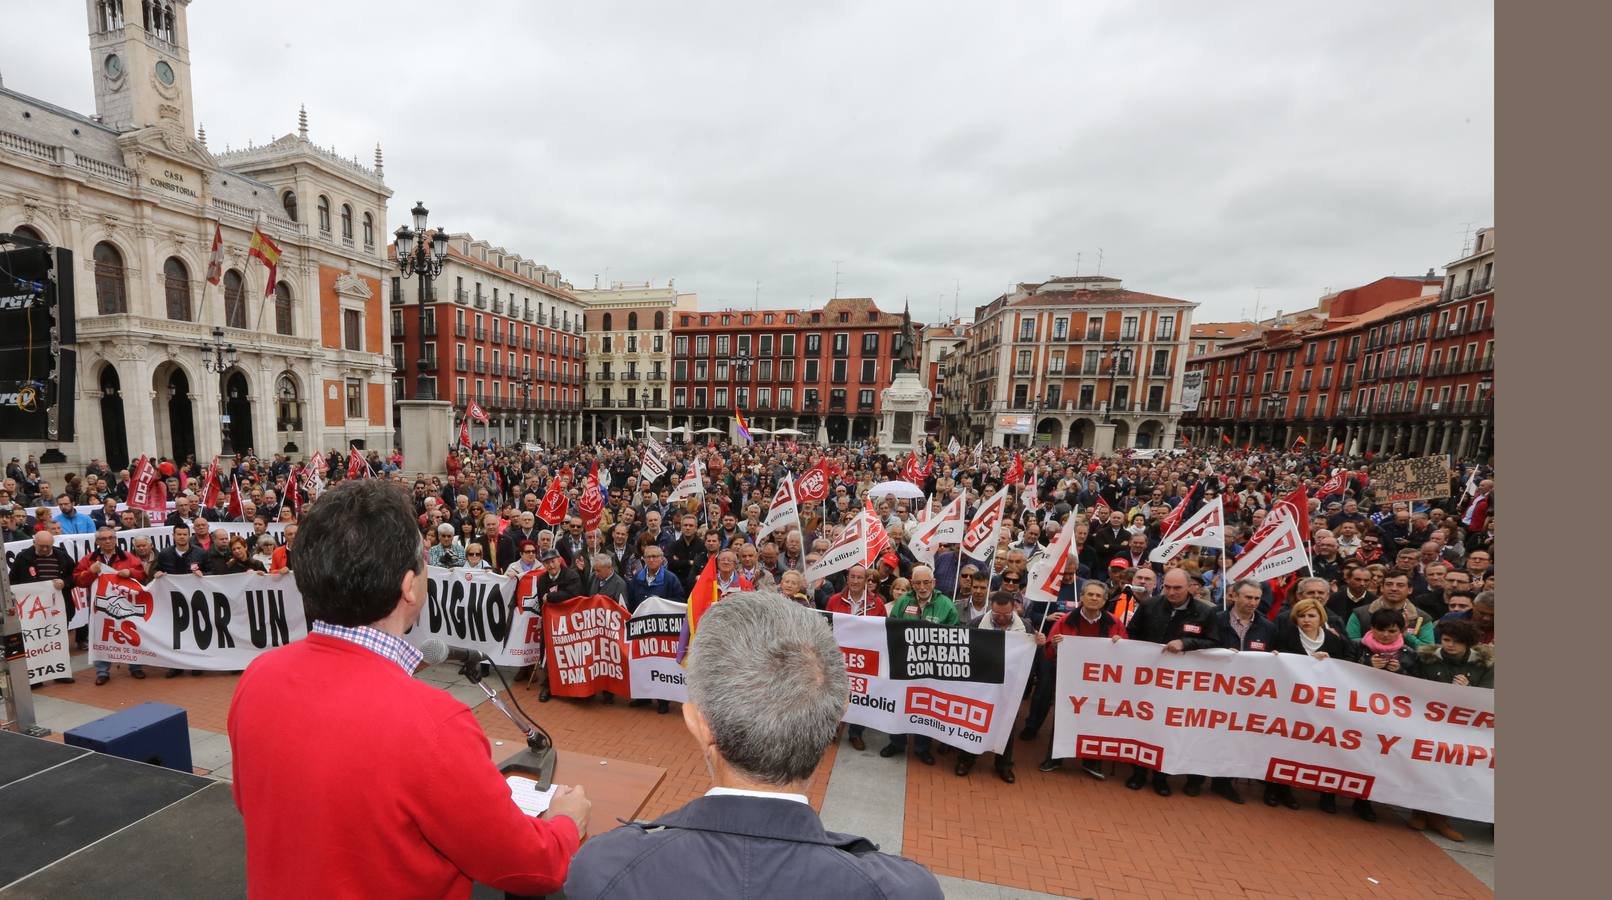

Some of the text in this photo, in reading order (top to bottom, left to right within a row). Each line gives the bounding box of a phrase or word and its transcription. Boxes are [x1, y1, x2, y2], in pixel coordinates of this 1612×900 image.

[151, 178, 199, 198] CONSISTORIAL
[164, 170, 184, 182] CASA
[170, 590, 289, 650] POR UN
[427, 578, 506, 642] DIGNO
[551, 607, 622, 636] LA CRISIS
[102, 618, 141, 647] FeS
[552, 632, 582, 645] TERMINA
[630, 618, 657, 637] EMPLEO
[658, 617, 669, 632] DE
[904, 628, 970, 644] QUIEREN
[554, 637, 622, 669] EMPLEO
[639, 637, 659, 656] NO
[661, 639, 670, 653] AL
[906, 646, 970, 663] ACABAR
[588, 661, 624, 681] TODOS
[907, 663, 971, 678] CON TODO
[1082, 662, 1123, 684] EN
[1134, 666, 1278, 699] DEFENSA
[1290, 683, 1337, 709] DE
[1348, 690, 1412, 719] LOS
[909, 691, 988, 728] CCOO
[909, 714, 984, 744] Castilla y León
[1069, 695, 1494, 769] Y LAS EMPLEADAS Y EMP
[1080, 738, 1158, 766] CCOO
[1272, 763, 1368, 794] CCOO
